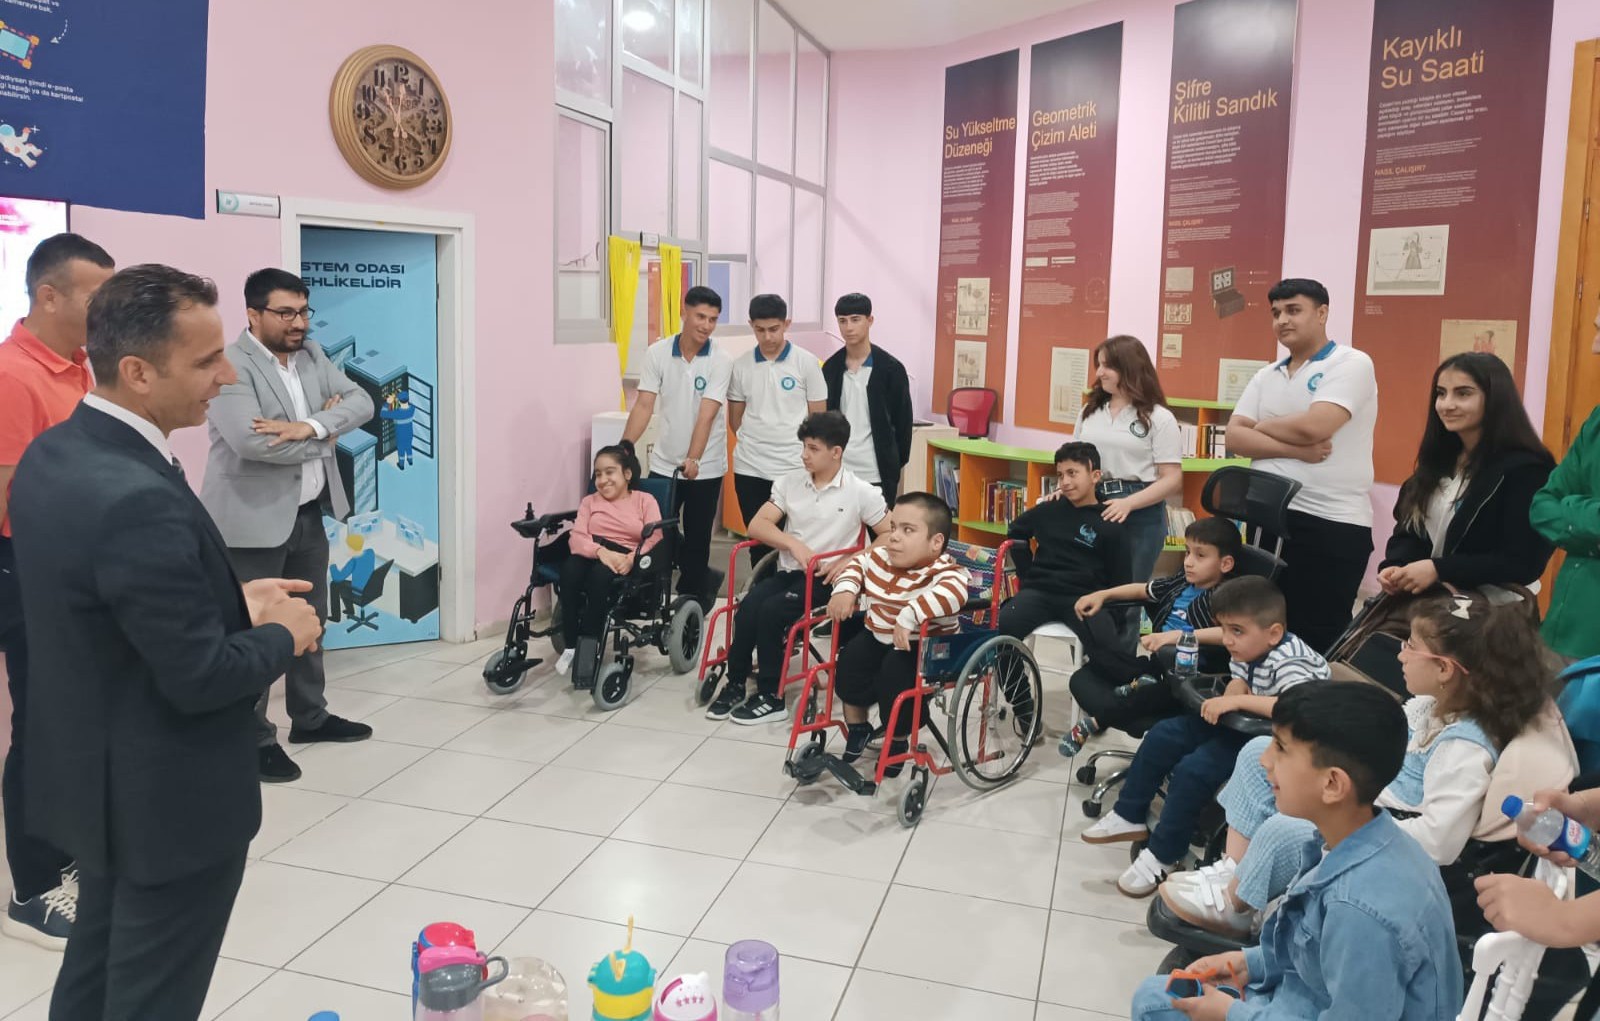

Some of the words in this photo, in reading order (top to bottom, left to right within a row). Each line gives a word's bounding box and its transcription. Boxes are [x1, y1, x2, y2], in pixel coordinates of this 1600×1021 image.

[1383, 25, 1462, 61] Kayıklı
[394, 64, 409, 84] 12
[1381, 66, 1412, 89] Su
[1421, 50, 1485, 82] Saati
[362, 85, 377, 101] 10
[1175, 79, 1212, 104] Şifre
[1032, 100, 1097, 127] Geometrik
[1173, 100, 1211, 124] Kilitli
[1215, 88, 1279, 117] Sandık
[945, 124, 959, 141] Su
[961, 116, 1016, 137] Yükseltme
[1031, 129, 1065, 151] Çizim
[1068, 121, 1097, 142] Aleti
[945, 137, 993, 159] Düzeneği
[355, 263, 405, 274] ODASI
